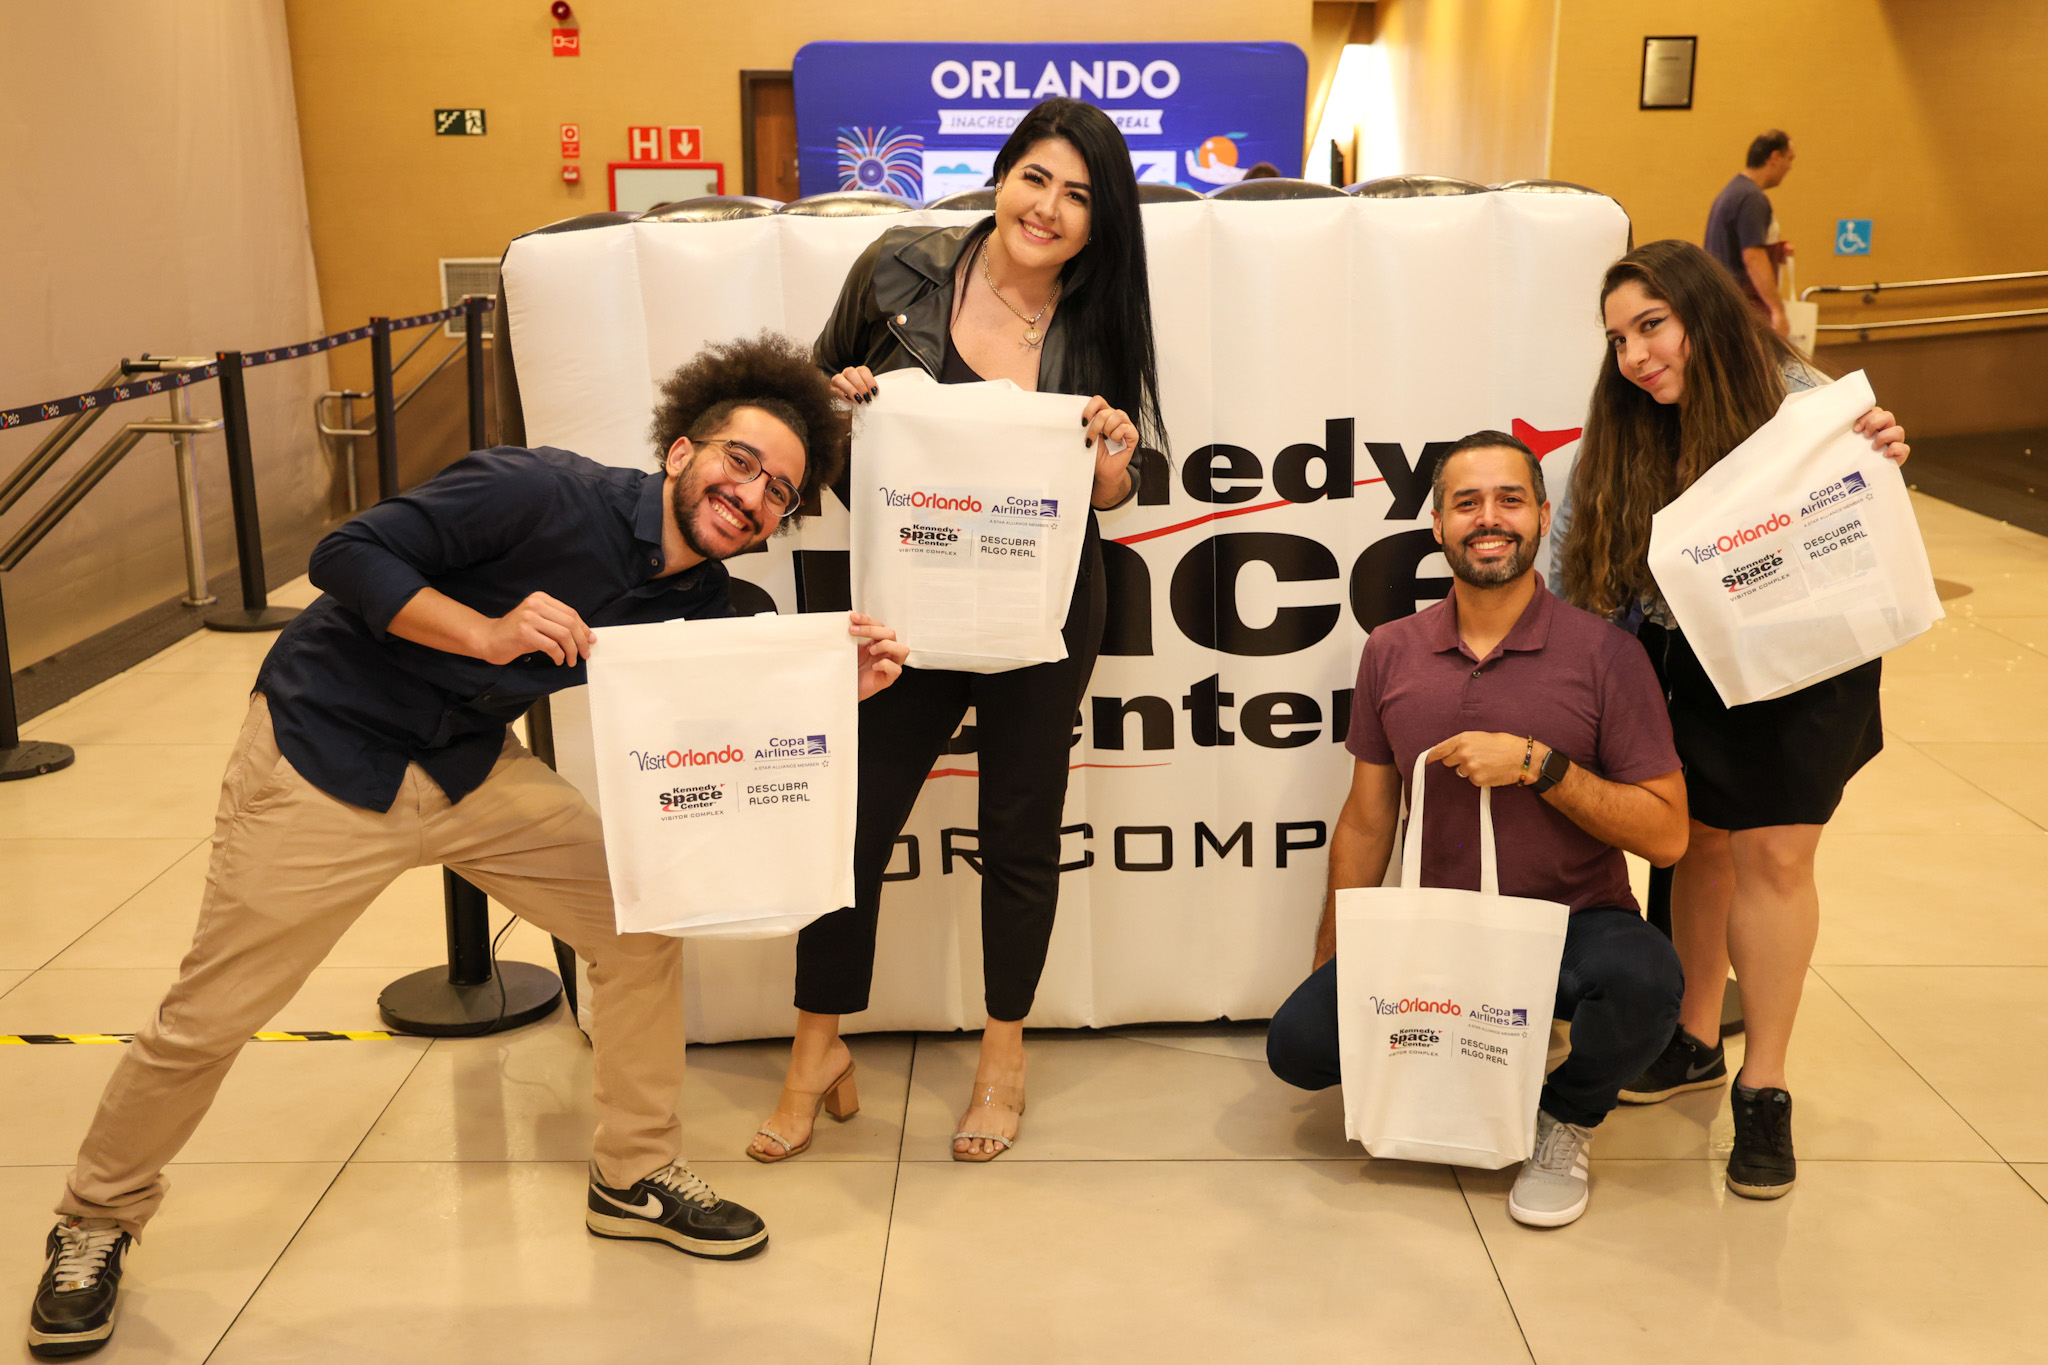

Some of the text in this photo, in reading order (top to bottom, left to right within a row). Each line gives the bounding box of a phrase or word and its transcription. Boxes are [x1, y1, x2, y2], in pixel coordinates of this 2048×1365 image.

[931, 59, 1181, 99] ORLANDO
[951, 116, 1149, 129] INACRED REAL
[632, 128, 659, 160] H
[1809, 482, 1842, 501] Copa
[1006, 496, 1039, 508] Copa
[1801, 490, 1847, 518] Airlines
[991, 505, 1038, 517] Airlines
[899, 527, 958, 542] Space
[913, 524, 954, 533] Kennedy
[1803, 519, 1862, 551] DESCUBRA
[918, 539, 949, 547] Center
[980, 535, 1036, 547] DESCUBRA
[1809, 530, 1868, 560] ALGO REAL
[980, 545, 1036, 558] ALGO REAL
[1733, 553, 1775, 574] Kennedy
[1721, 556, 1784, 588] Space
[1746, 568, 1778, 586] Center
[1730, 573, 1790, 602] VISITOR COMPLEX
[769, 737, 805, 748] Copa
[754, 747, 805, 759] Airlines
[673, 784, 717, 794] Kennedy
[747, 781, 809, 794] DESCUBRA
[659, 790, 723, 807] Space
[749, 793, 811, 806] ALGO REAL
[680, 801, 713, 810] Center
[690, 810, 724, 818] COMPLEX
